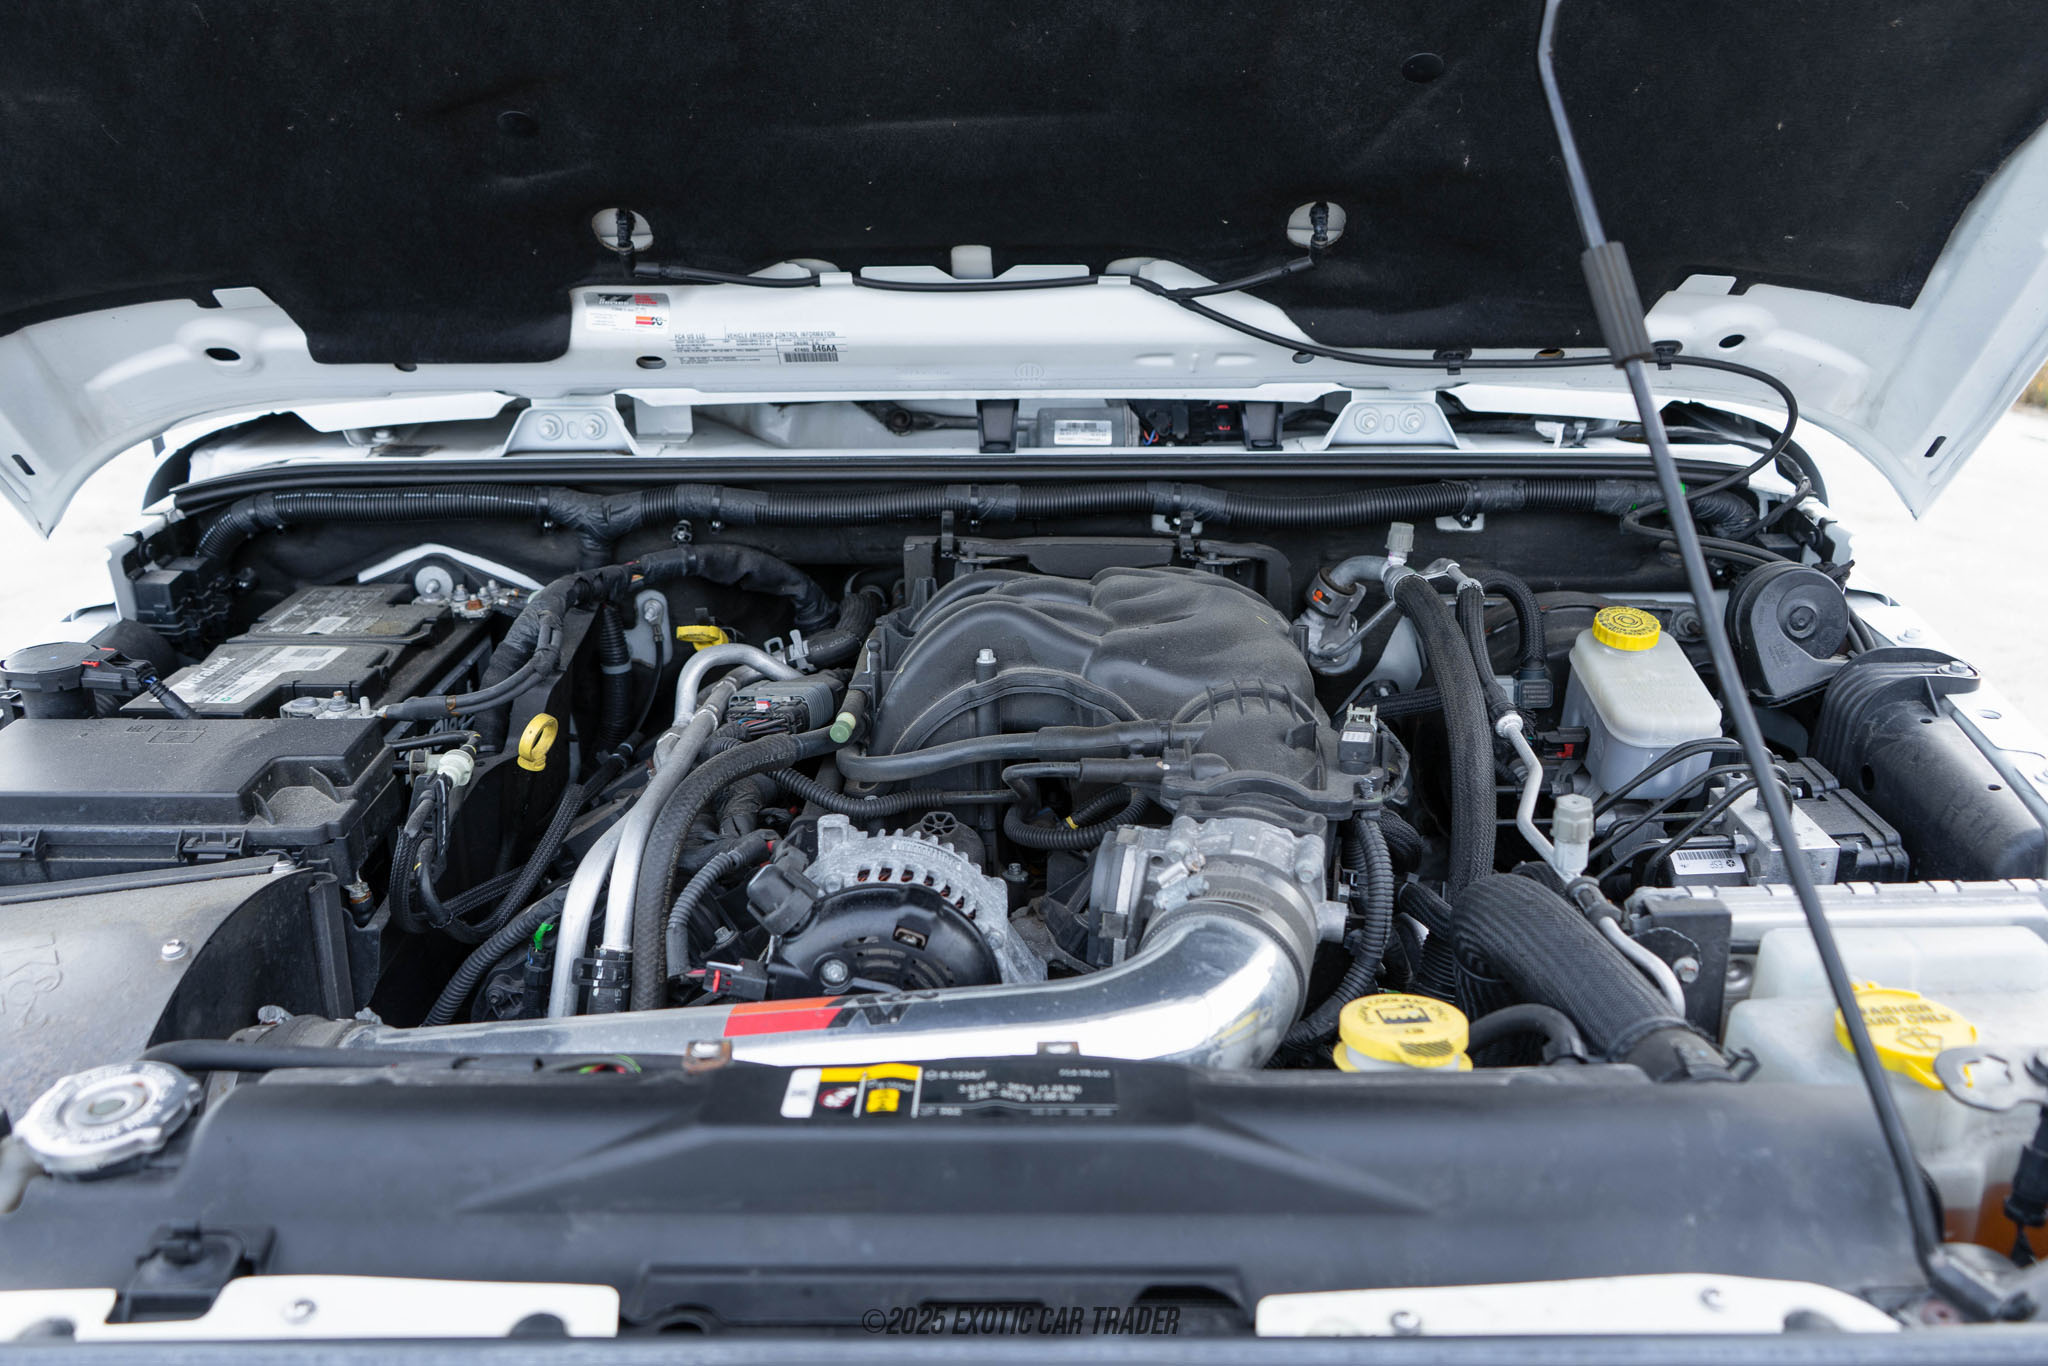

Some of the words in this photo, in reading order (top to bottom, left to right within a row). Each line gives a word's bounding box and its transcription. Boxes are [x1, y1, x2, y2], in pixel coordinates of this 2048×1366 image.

[727, 332, 747, 340] VEHICLE
[775, 331, 799, 339] CONTROL
[178, 655, 237, 691] Duralast
[1860, 1004, 1931, 1016] ASHER
